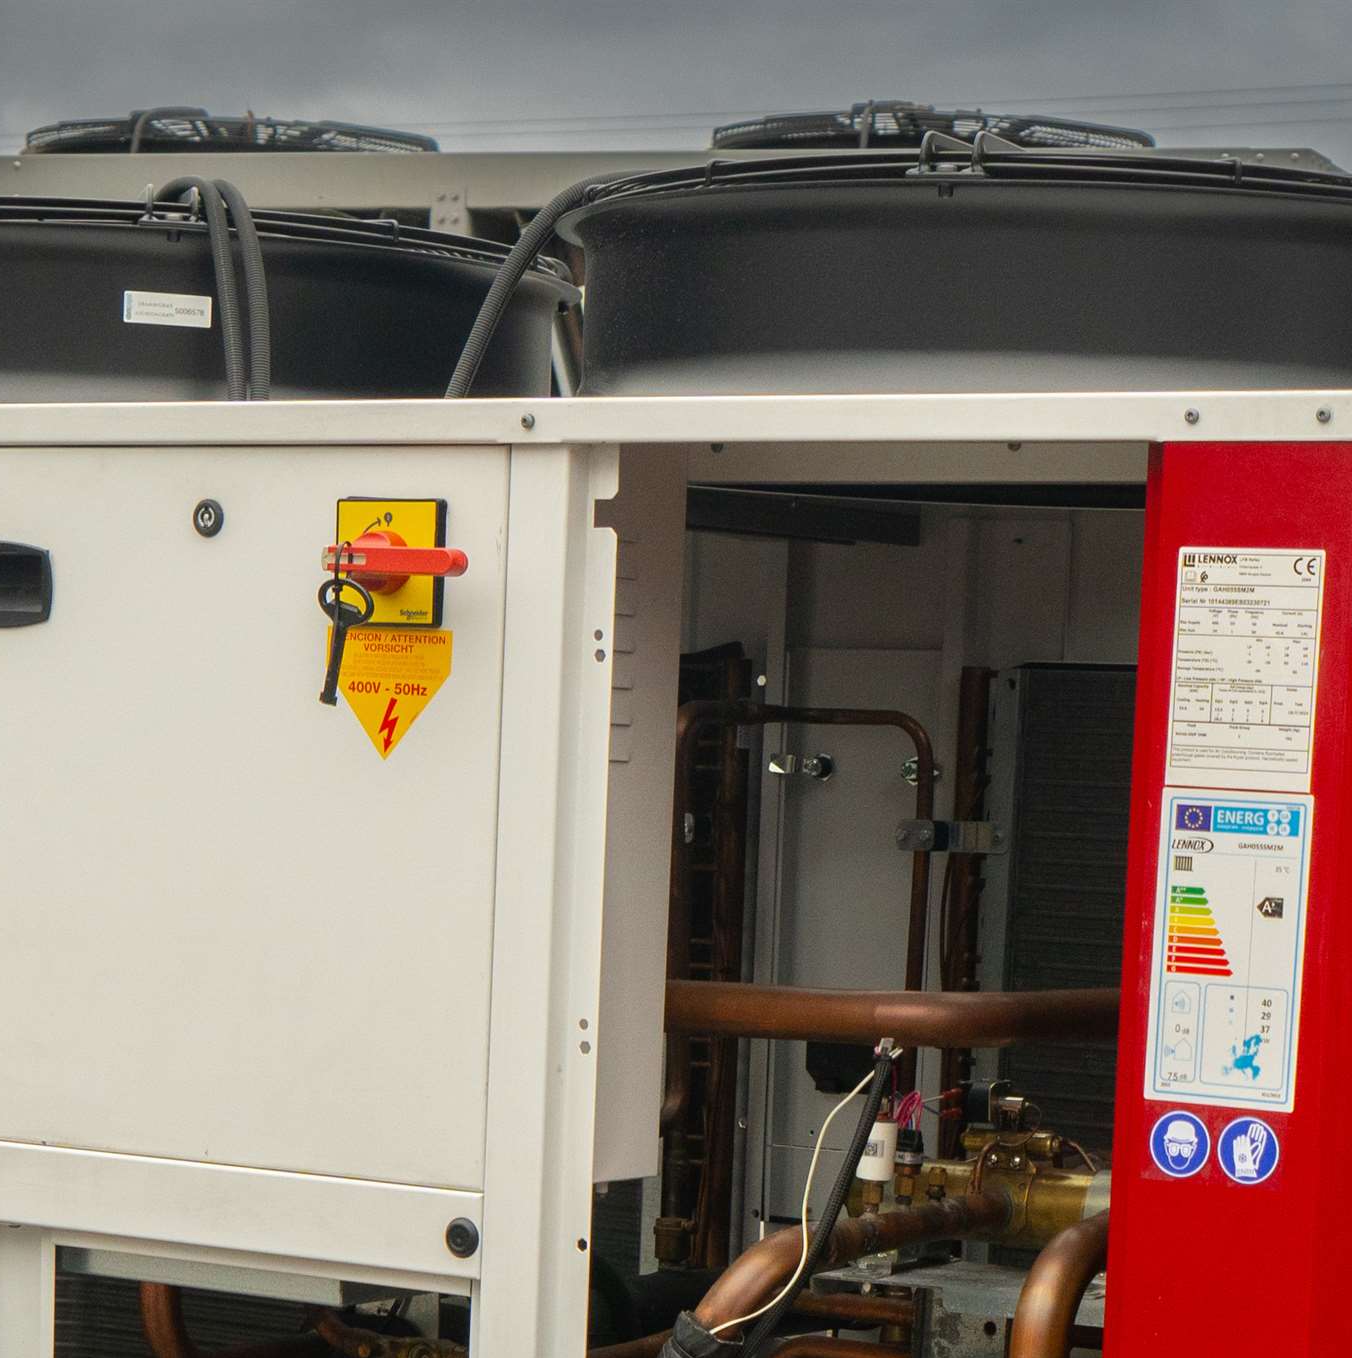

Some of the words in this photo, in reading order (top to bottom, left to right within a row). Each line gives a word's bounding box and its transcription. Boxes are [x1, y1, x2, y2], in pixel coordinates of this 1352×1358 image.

[1198, 554, 1238, 565] LENNOX
[390, 634, 446, 645] ATTENTION
[364, 644, 415, 653] VORSICHT
[348, 681, 381, 694] 400V
[394, 683, 428, 696] 50Hz
[1217, 809, 1265, 825] ENERG
[1172, 839, 1206, 850] LENNOX
[1261, 999, 1272, 1008] 40
[1260, 1012, 1271, 1020] 29
